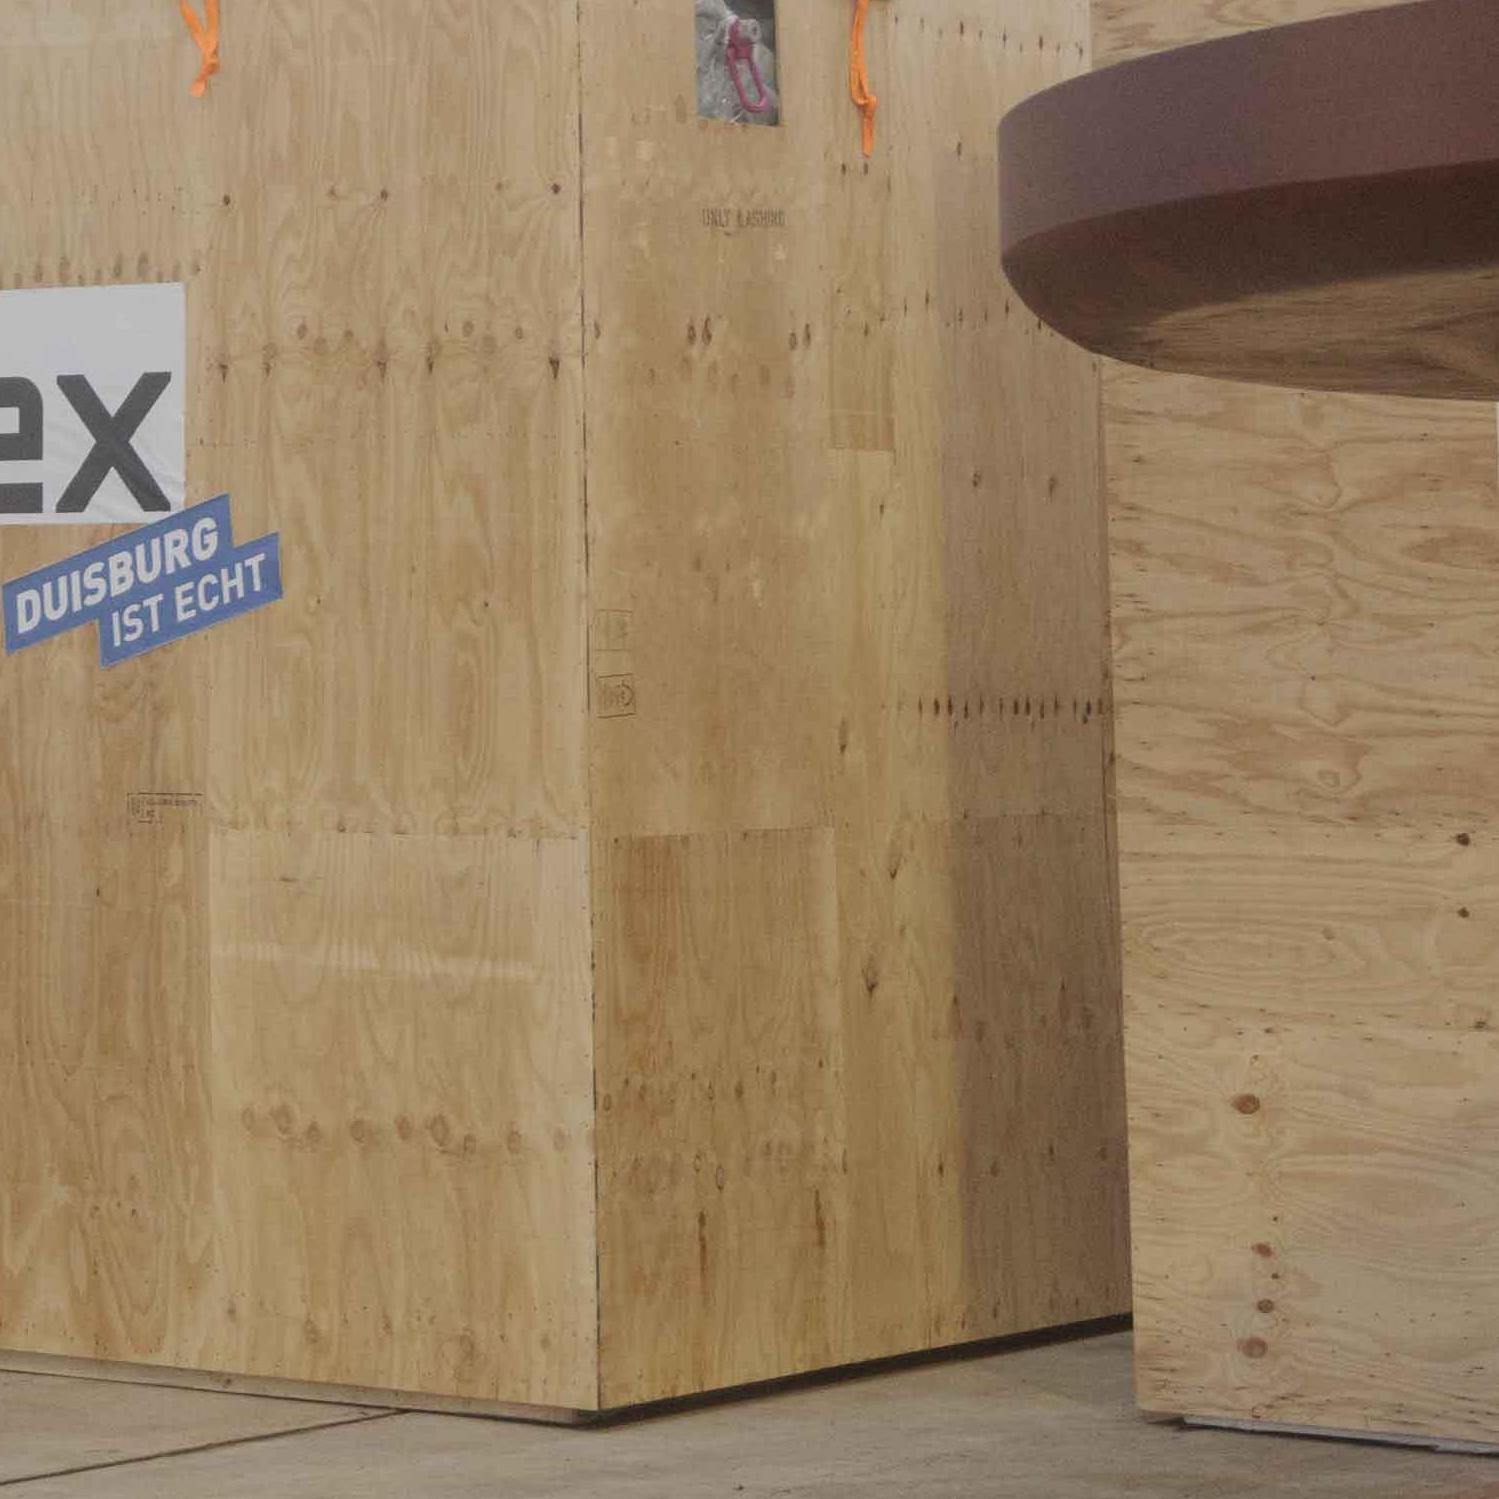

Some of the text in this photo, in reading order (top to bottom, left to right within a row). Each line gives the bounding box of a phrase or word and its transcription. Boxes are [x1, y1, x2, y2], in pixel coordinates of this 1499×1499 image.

[701, 207, 731, 227] ONLY
[15, 517, 219, 634] DUISBURG
[112, 553, 266, 647] IST ECHT
